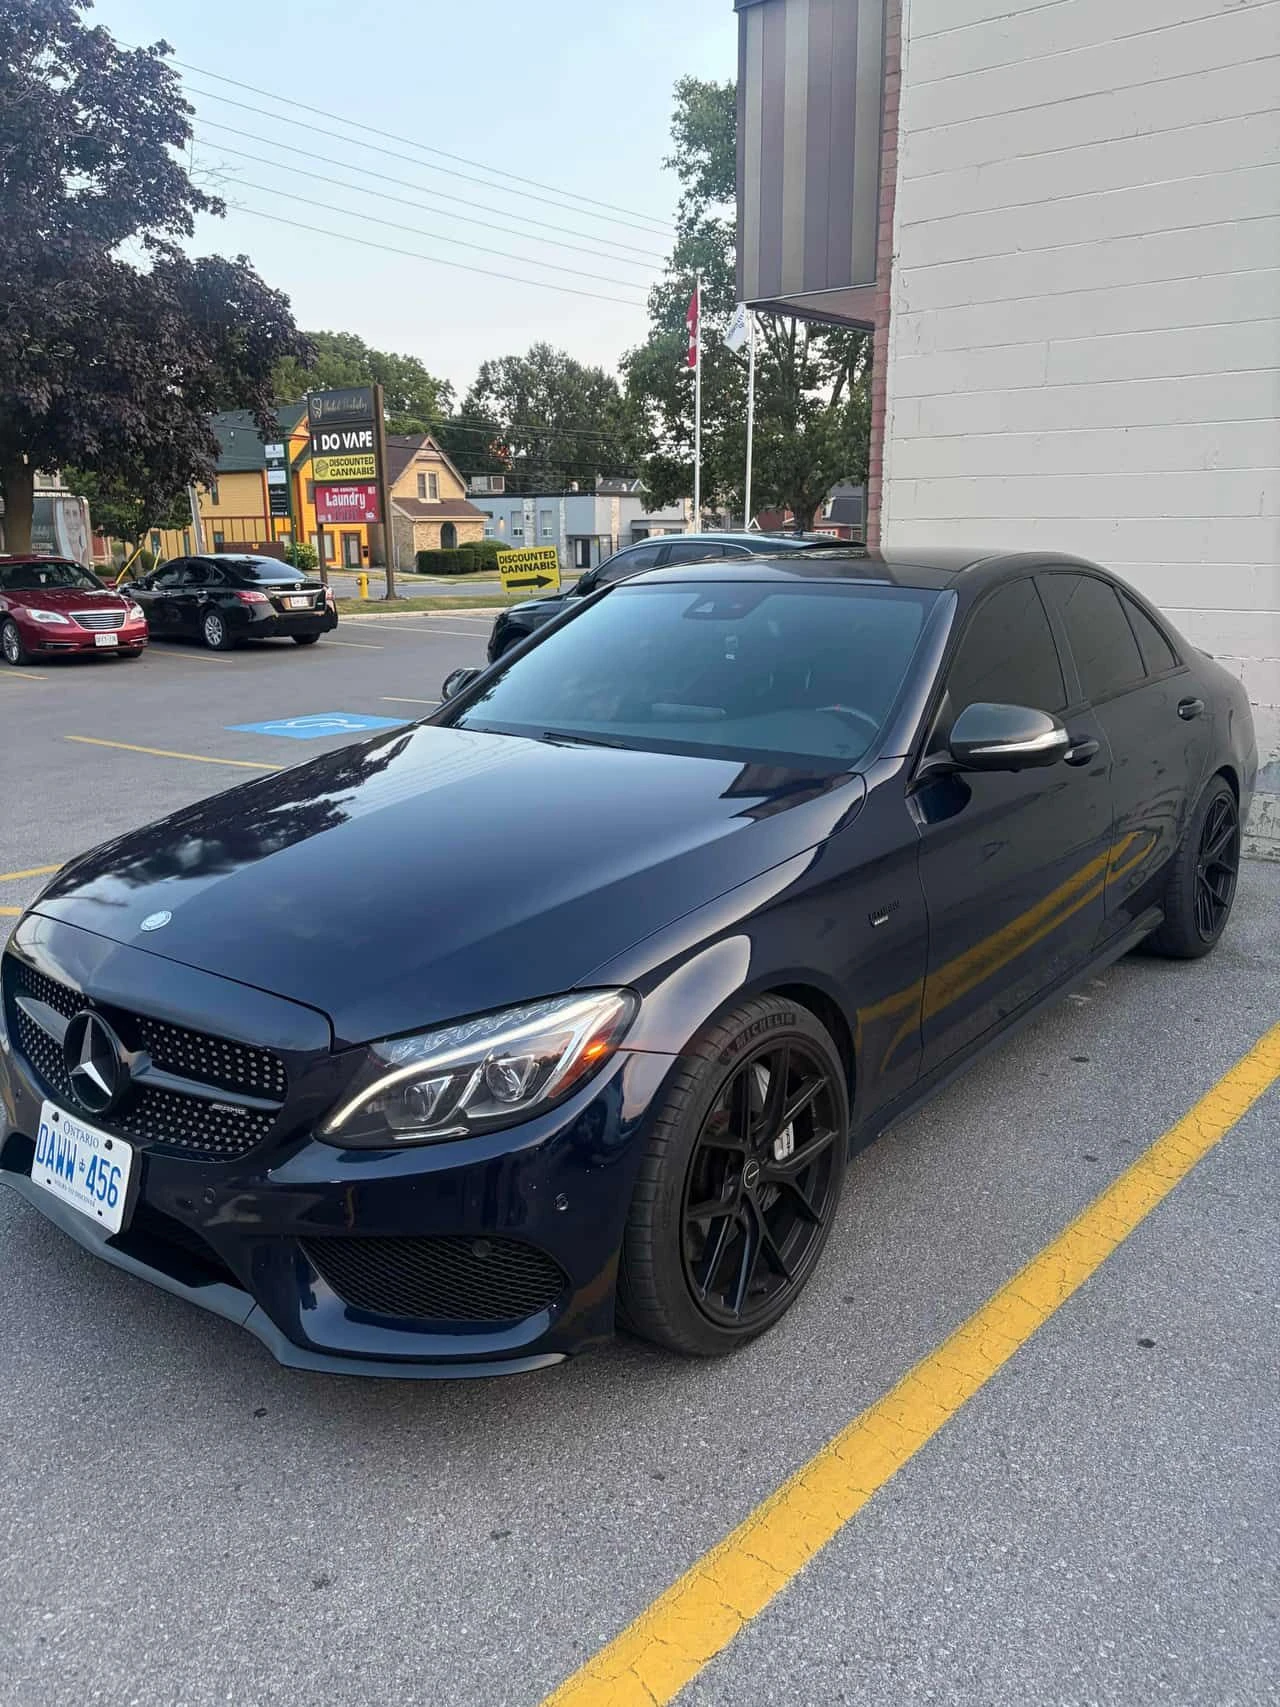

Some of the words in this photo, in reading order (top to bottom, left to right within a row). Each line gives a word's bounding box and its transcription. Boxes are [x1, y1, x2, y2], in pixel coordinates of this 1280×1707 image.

[321, 433, 340, 451] DO
[342, 430, 373, 449] VAPE
[329, 456, 374, 467] DISCOUNTED
[329, 467, 375, 477] CANNABIS
[325, 491, 366, 510] Laundry
[499, 550, 556, 564] DISCOUNTED
[500, 560, 557, 574] CANNABIS
[63, 1120, 99, 1149] ONTARIO
[36, 1123, 77, 1183] DAWW
[85, 1154, 121, 1208] 456
